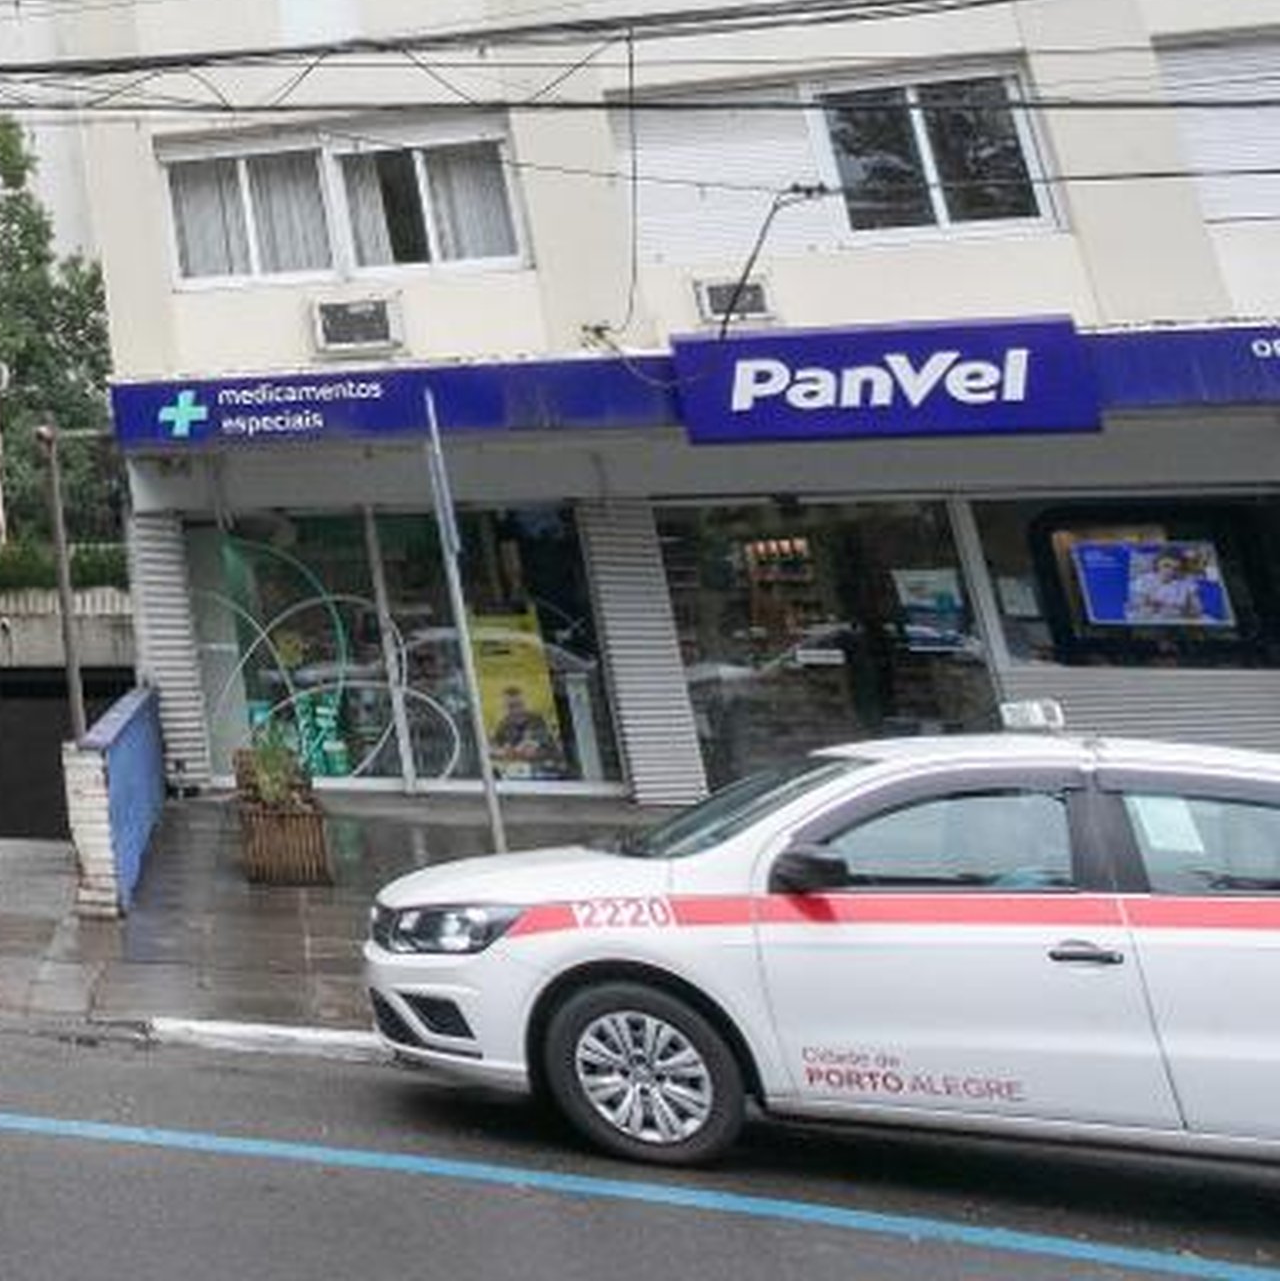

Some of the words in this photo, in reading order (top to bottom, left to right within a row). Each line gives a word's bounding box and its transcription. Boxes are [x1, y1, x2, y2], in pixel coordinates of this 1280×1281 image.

[217, 381, 383, 406] medicamentos
[731, 347, 1030, 413] PanVel
[222, 409, 324, 437] especiais
[577, 896, 671, 928] 2220
[804, 1065, 905, 1094] PORTO
[909, 1073, 1024, 1099] ALEGRE
